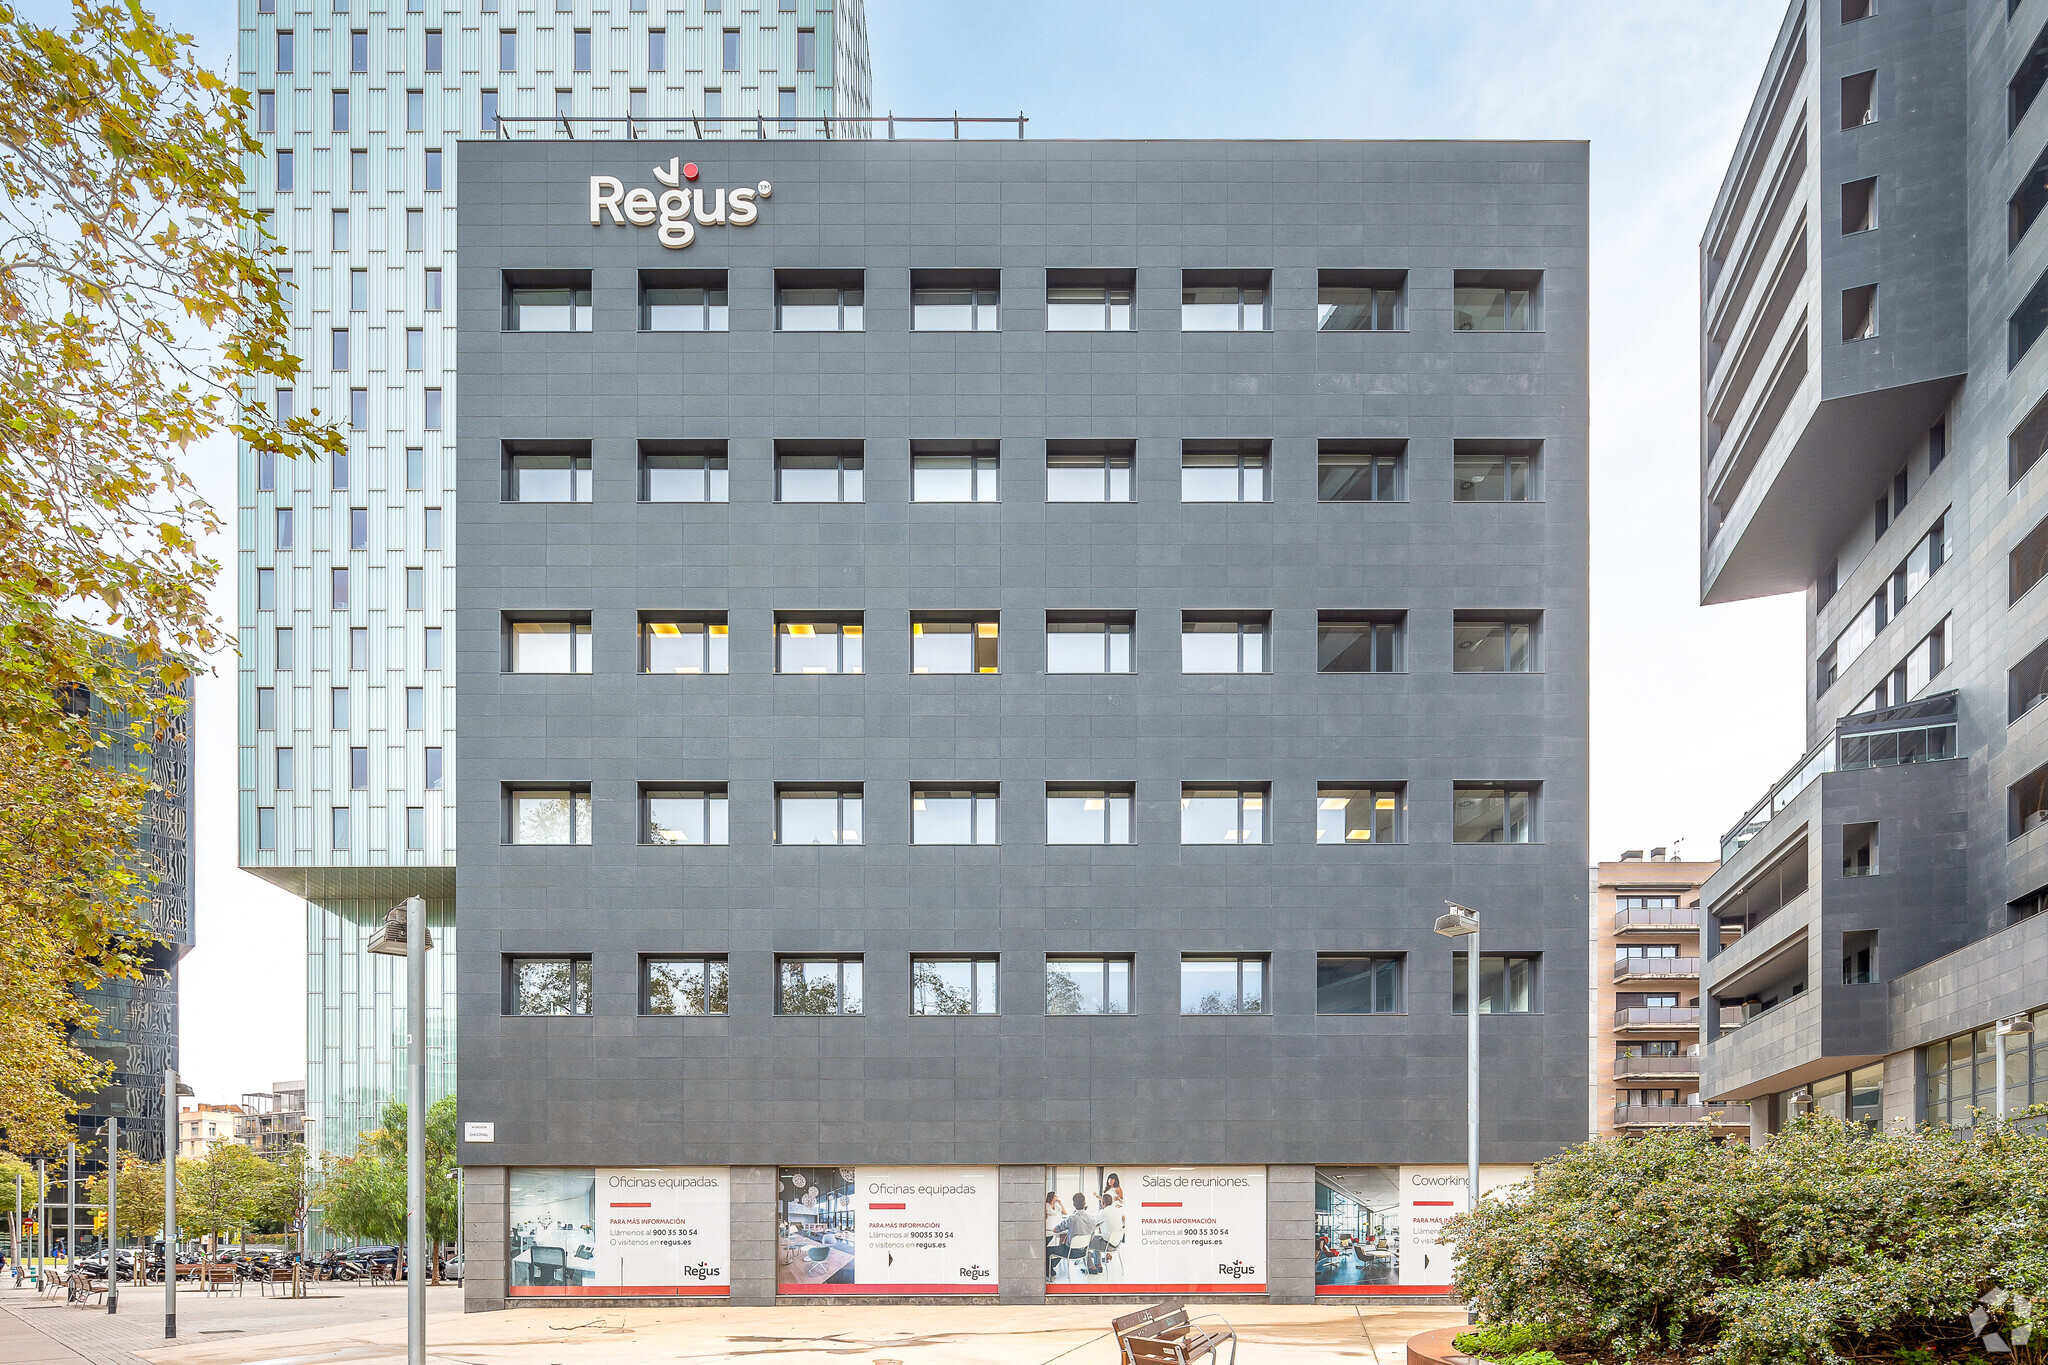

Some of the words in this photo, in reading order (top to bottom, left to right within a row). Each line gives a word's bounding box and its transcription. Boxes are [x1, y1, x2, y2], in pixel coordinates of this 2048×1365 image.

[589, 174, 758, 249] Regus
[609, 1176, 656, 1188] Oficinas
[658, 1176, 719, 1189] equipadas.
[1142, 1175, 1172, 1187] Salas
[1174, 1176, 1189, 1187] de
[1191, 1176, 1250, 1187] reuniones.
[869, 1183, 915, 1194] Oficinas
[918, 1184, 976, 1196] equipadas
[684, 1266, 720, 1280] Regus
[960, 1268, 989, 1280] Regus
[1219, 1264, 1254, 1279] Regus
